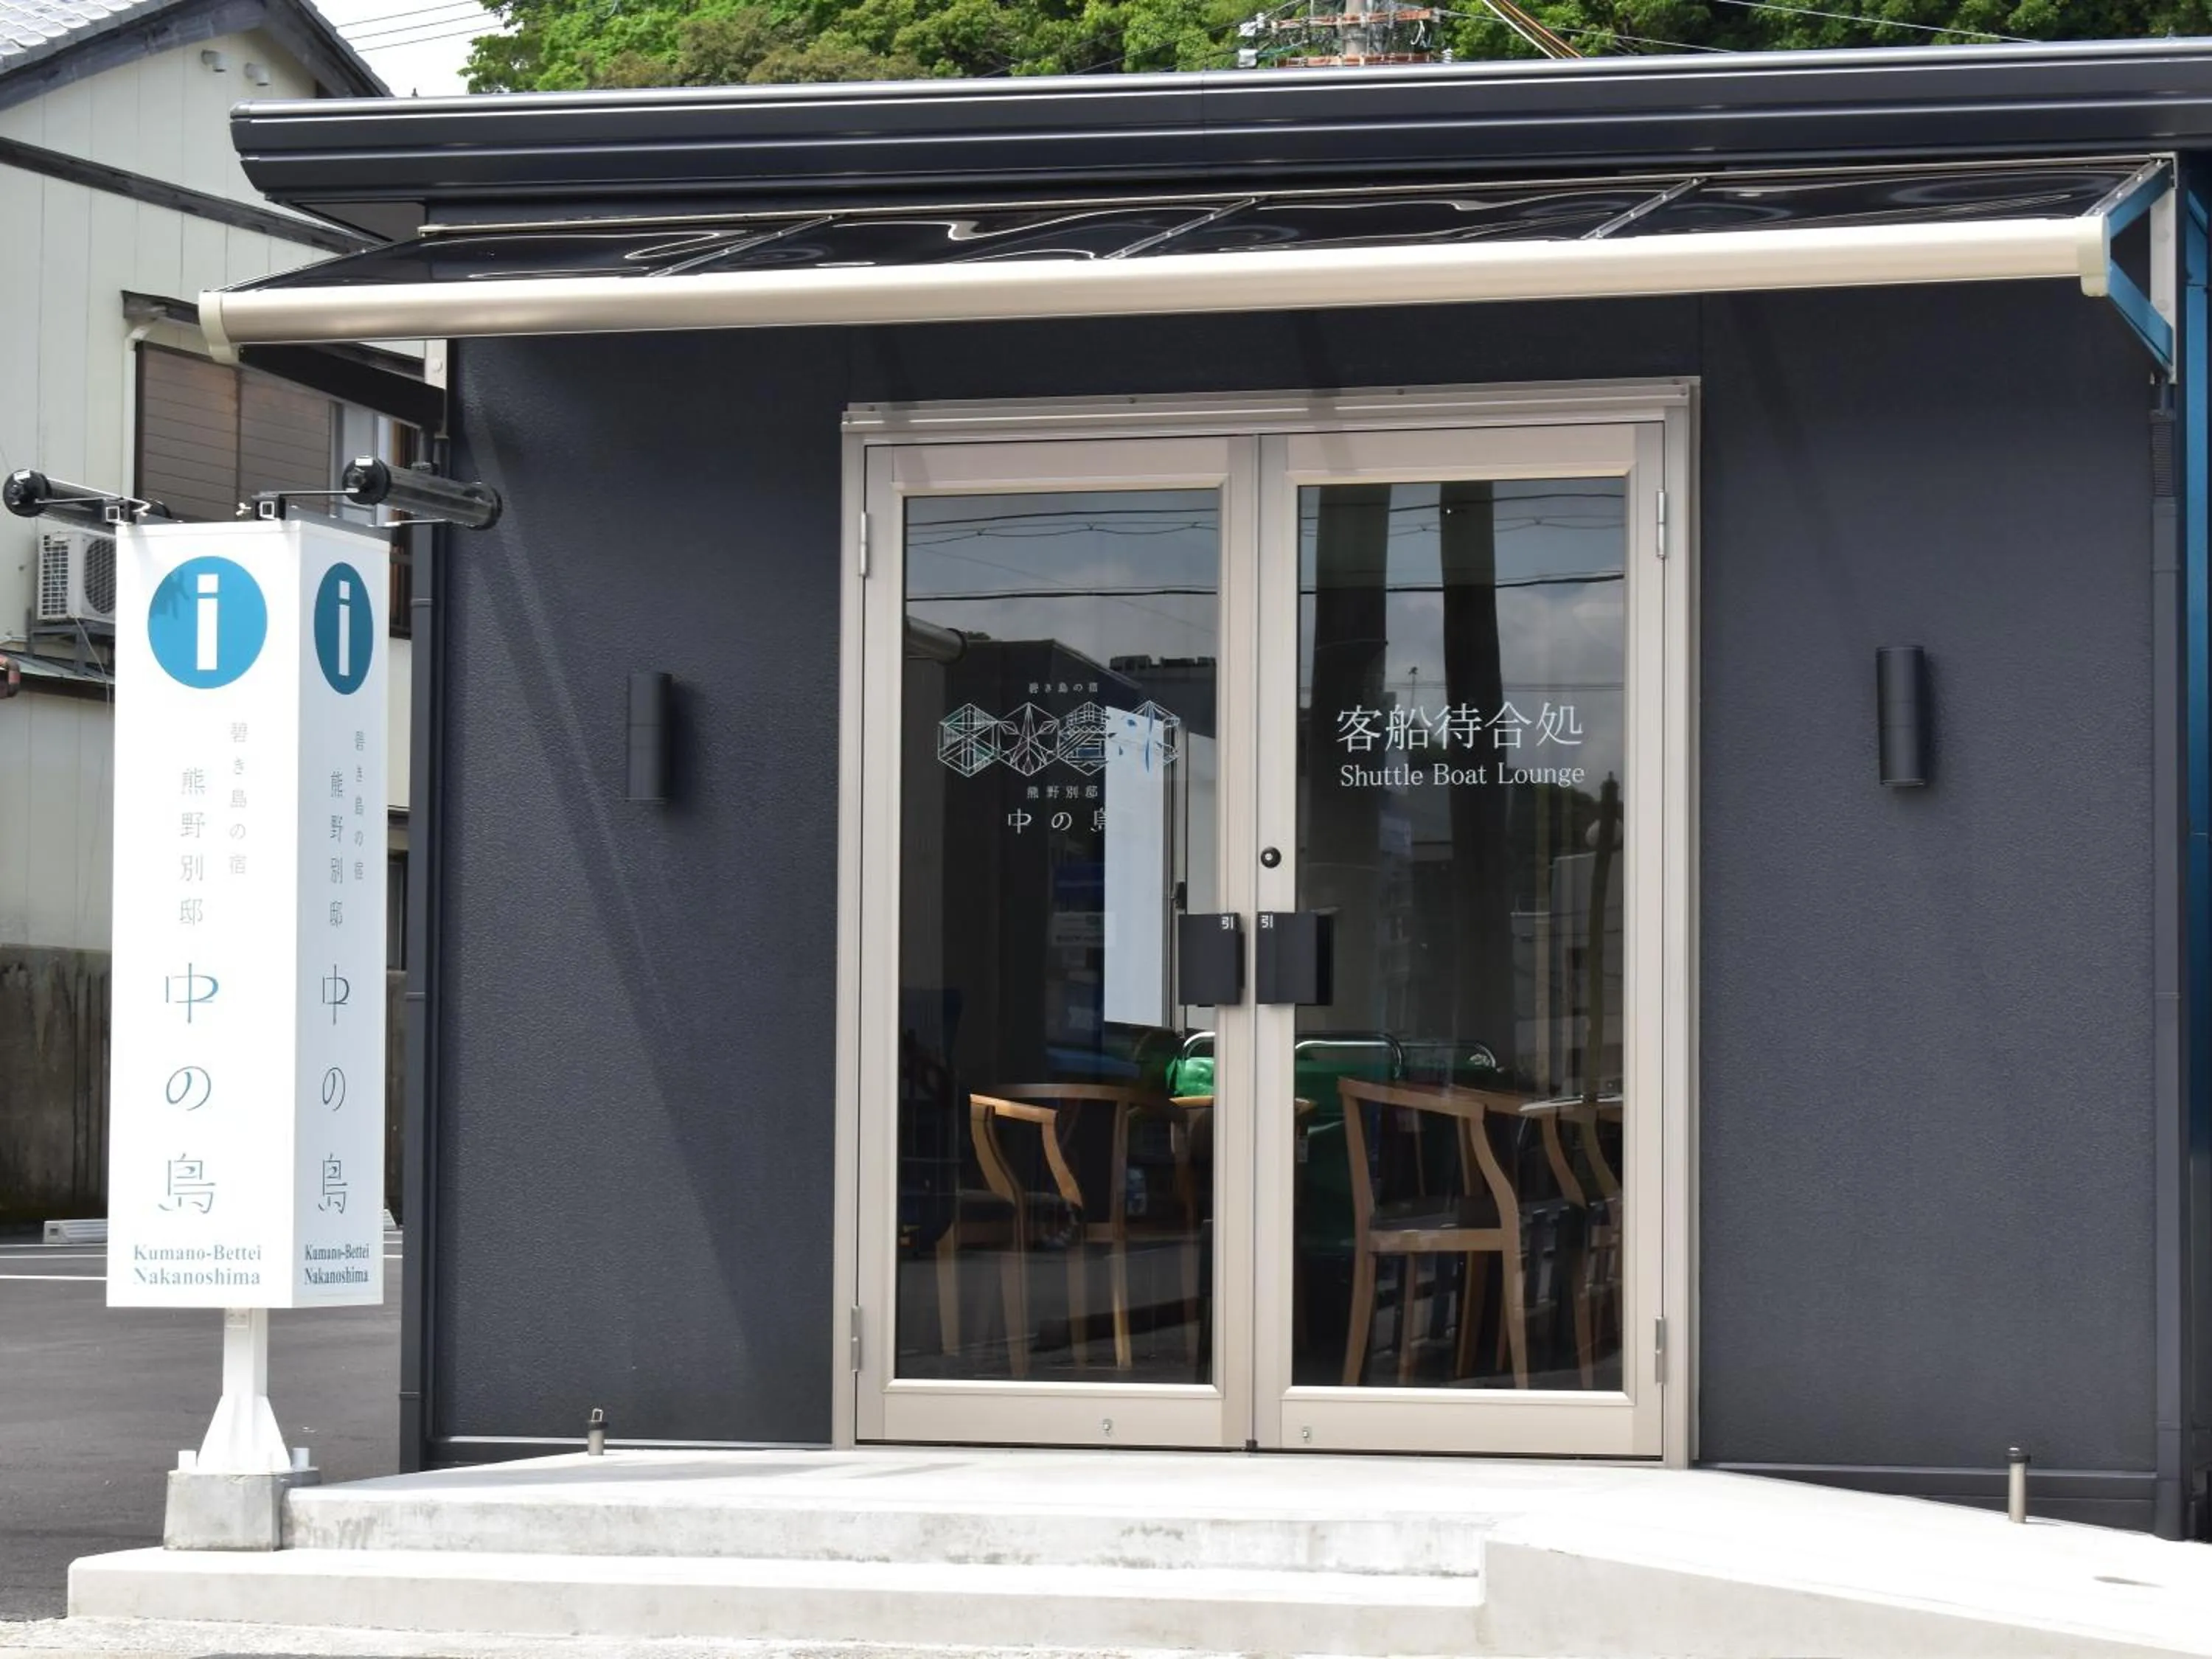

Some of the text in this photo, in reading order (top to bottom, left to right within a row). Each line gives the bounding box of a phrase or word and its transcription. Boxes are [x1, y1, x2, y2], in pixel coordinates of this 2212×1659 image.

[1336, 701, 1584, 753] 客船待合処
[1340, 762, 1586, 787] Shuttle Boat Lounge
[178, 767, 206, 927] 熊野別邸
[1222, 916, 1234, 930] 引
[1261, 915, 1273, 928] 引
[133, 1244, 262, 1262] Kumano-Bettei
[305, 1244, 369, 1262] Kumano-Bettei
[133, 1267, 261, 1286] Nakanoshima
[304, 1266, 369, 1285] Nakanoshima
